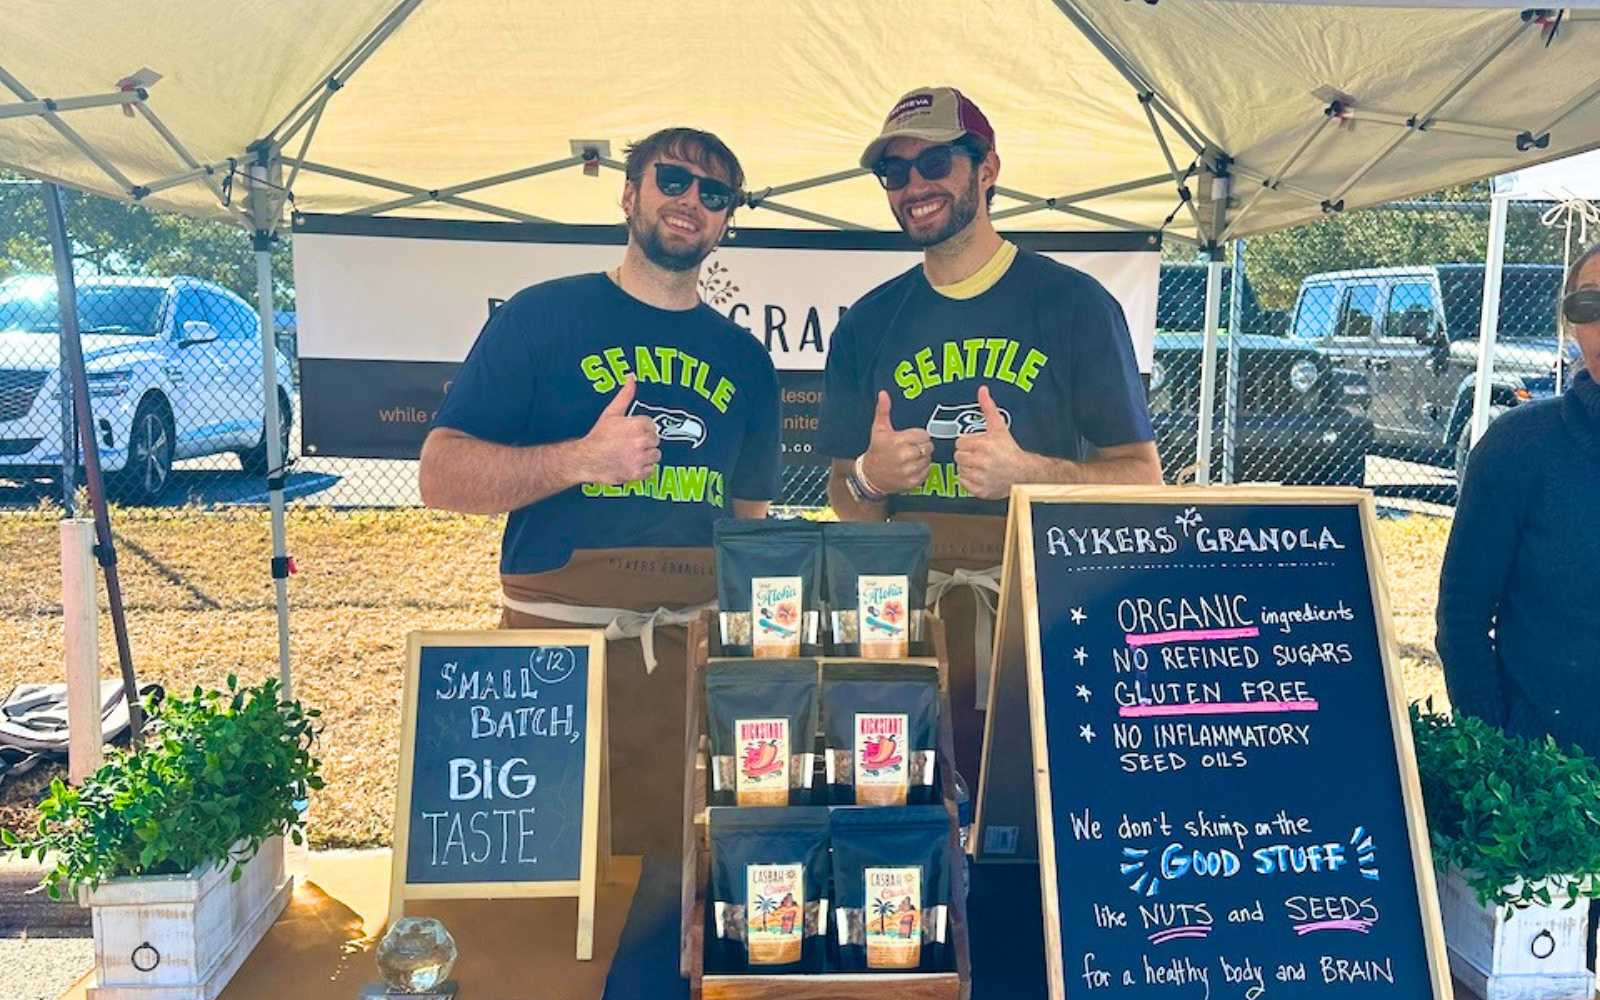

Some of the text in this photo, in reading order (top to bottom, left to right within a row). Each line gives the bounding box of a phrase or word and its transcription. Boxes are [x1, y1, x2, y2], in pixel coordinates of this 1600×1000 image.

[581, 346, 736, 414] SEATTLE
[894, 338, 1048, 400] SEATTLE
[379, 406, 427, 423] while
[1047, 526, 1345, 556] RYKERS GRANOLA
[1118, 595, 1354, 633] ORGANIC ingredients
[1113, 643, 1353, 673] NO REFINED SUGARS
[436, 661, 538, 700] SMALL
[1114, 681, 1316, 706] GLUTEN FREE
[471, 704, 581, 744] BATCH,
[1113, 723, 1311, 750] NO INFLAMMATORY
[449, 757, 537, 801] BIG
[1120, 751, 1248, 772] SEED OILS
[422, 807, 538, 866] TASTE
[1070, 809, 1312, 850] We don't skimp on the
[1160, 842, 1347, 880] GOOD STUFF
[1094, 896, 1380, 929] like NUTS and SEEDS
[1081, 952, 1395, 1000] for a healthy body and BRAIN
